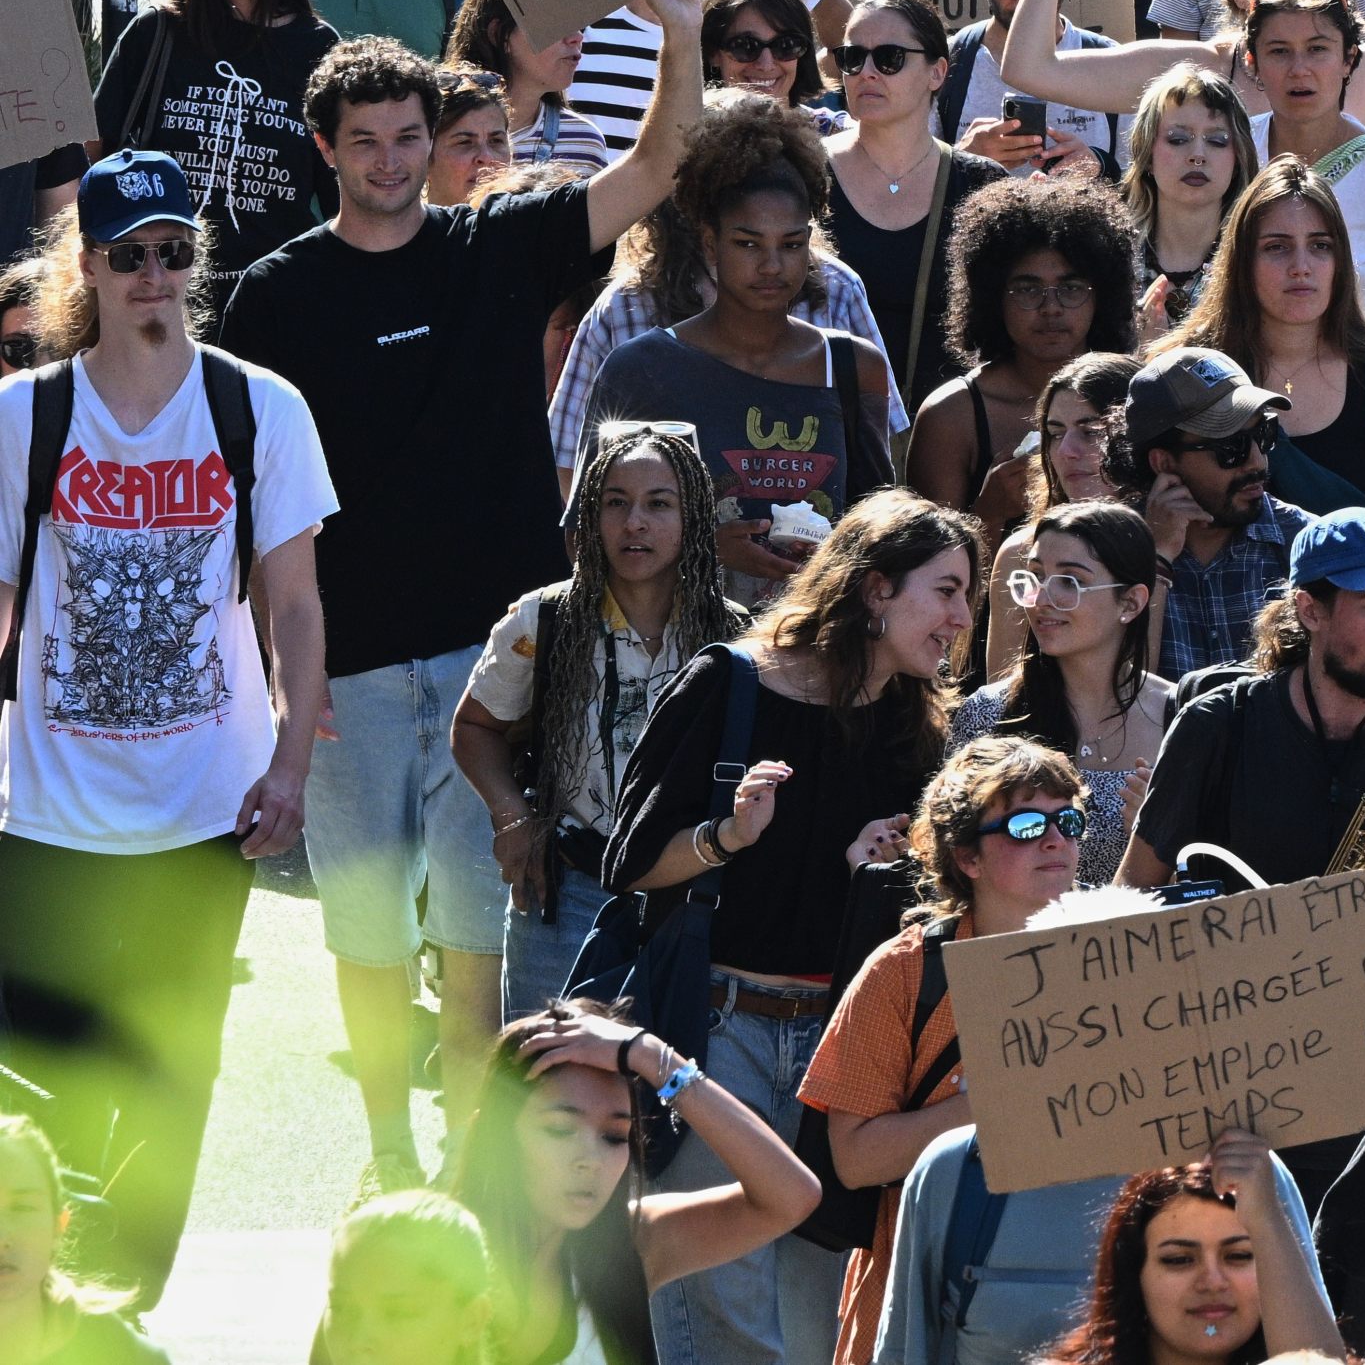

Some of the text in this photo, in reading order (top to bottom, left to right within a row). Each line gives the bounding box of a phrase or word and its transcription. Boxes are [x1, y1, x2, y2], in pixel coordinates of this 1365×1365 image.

[187, 85, 288, 114] IF YOU WANT
[163, 98, 307, 137] SOMETHING YOU'VE
[198, 135, 279, 163] YOU MUST
[242, 162, 265, 179] TO
[268, 166, 291, 184] DO
[241, 179, 297, 202] YOU'VE
[740, 457, 816, 474] BURGER
[51, 444, 236, 530] KREATOR
[748, 477, 808, 491] WORLD
[1182, 888, 1217, 899] WALTHER
[1000, 1003, 1124, 1069] AUSSI
[1142, 950, 1345, 1033] CHARGÉE
[1045, 1066, 1147, 1139] MON
[1140, 1085, 1304, 1157] TEMPS
